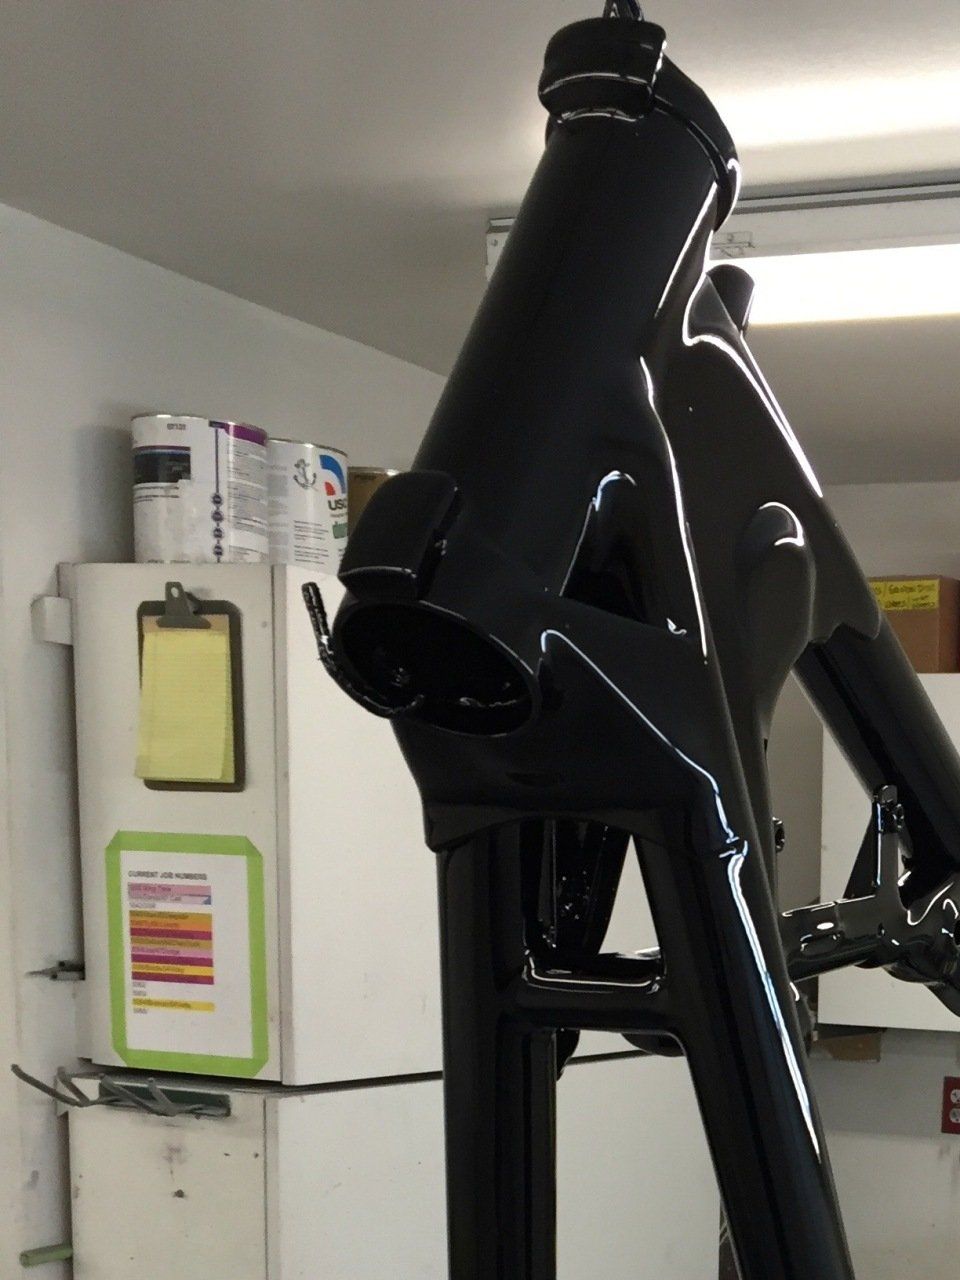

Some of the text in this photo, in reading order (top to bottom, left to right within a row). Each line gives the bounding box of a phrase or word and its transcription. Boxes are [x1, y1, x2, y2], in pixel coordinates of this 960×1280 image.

[128, 870, 207, 880] CURRENT JOB NUMBERS
